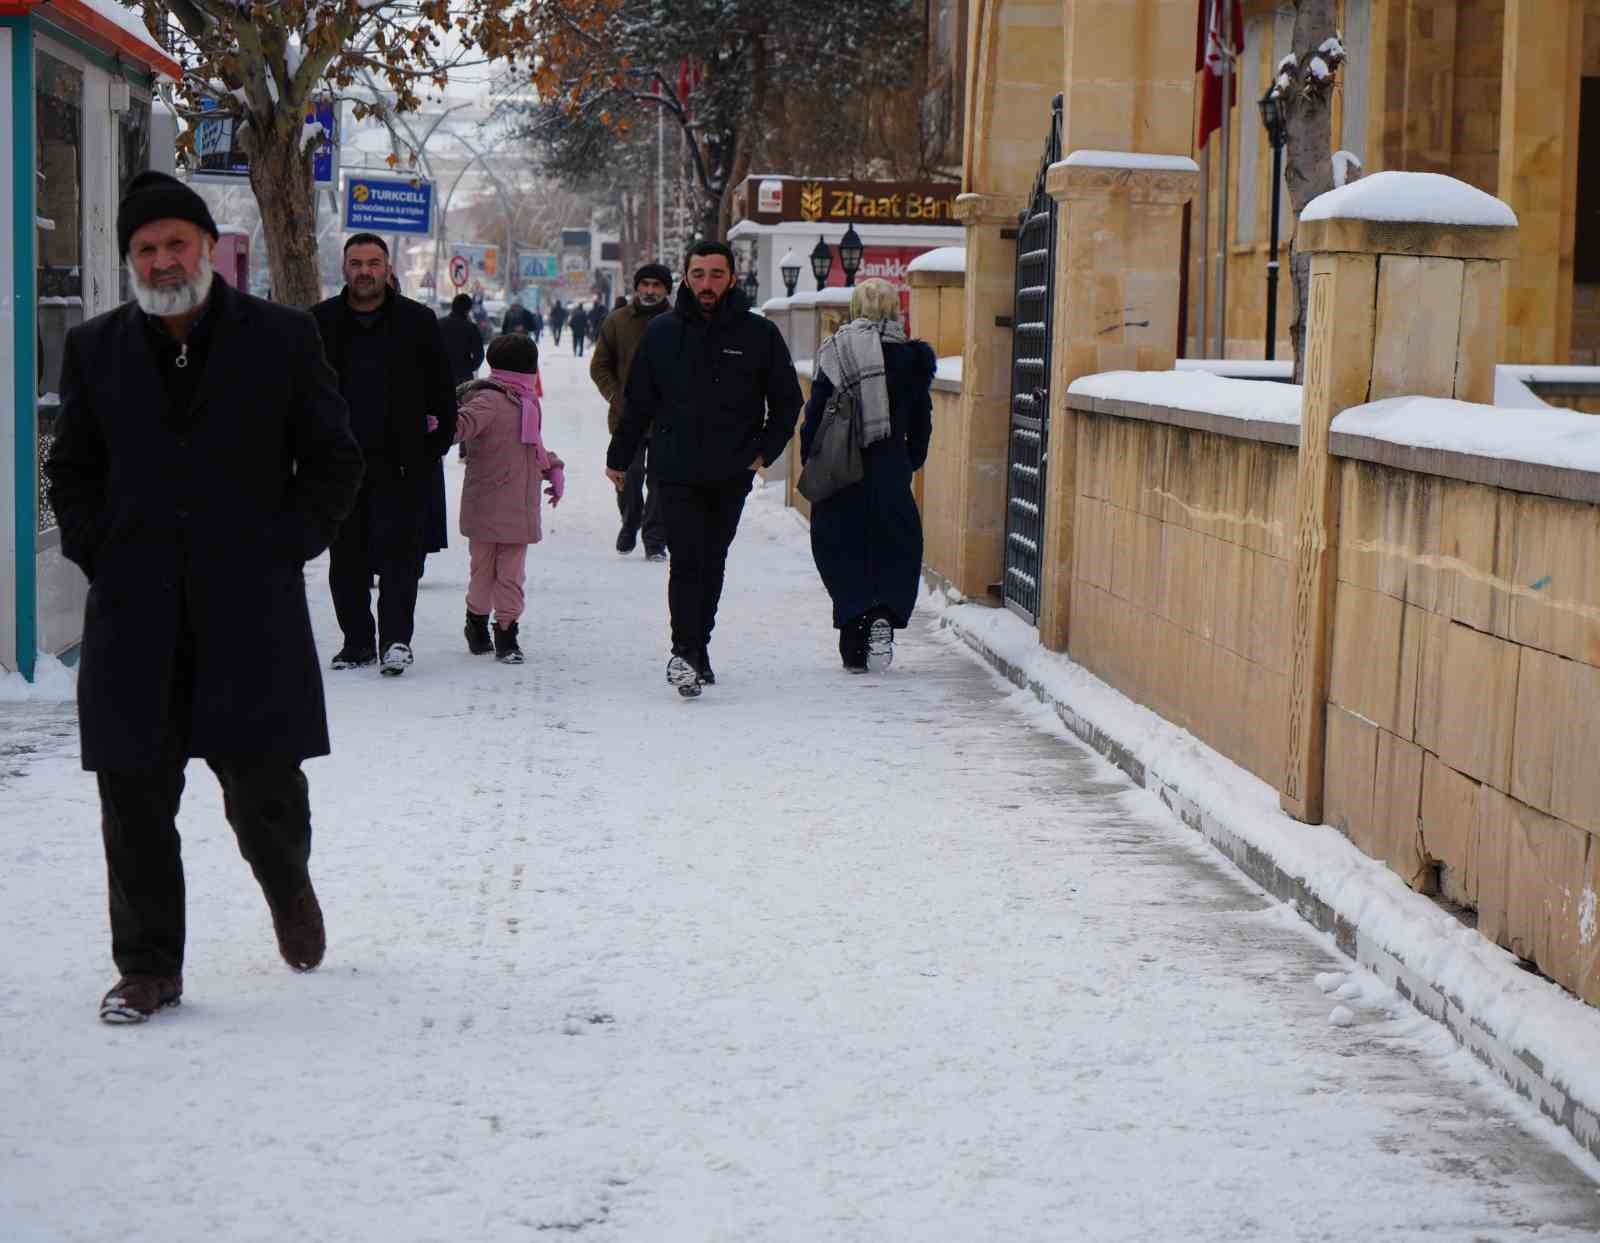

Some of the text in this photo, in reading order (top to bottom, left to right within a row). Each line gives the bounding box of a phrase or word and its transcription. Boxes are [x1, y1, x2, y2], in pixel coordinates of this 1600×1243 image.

[370, 189, 426, 203] TURKCELL
[830, 191, 900, 218] Ziraat
[855, 258, 908, 277] Bankk
